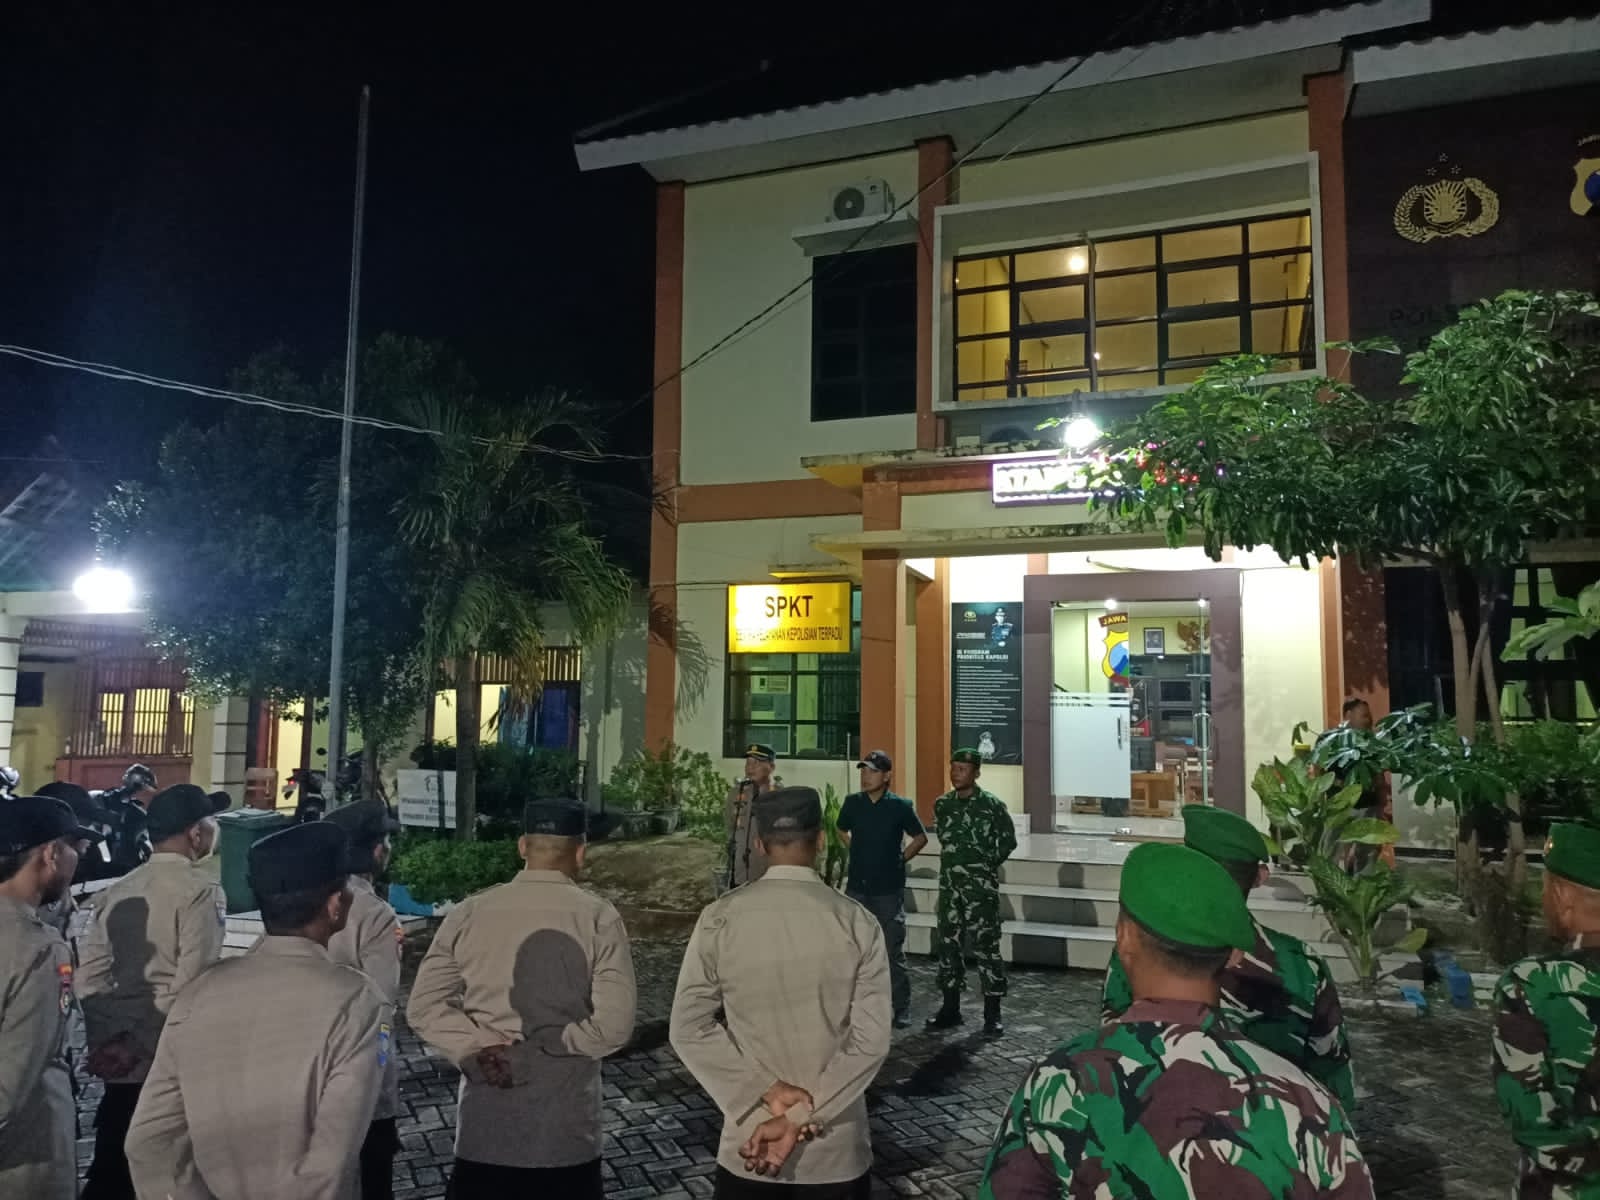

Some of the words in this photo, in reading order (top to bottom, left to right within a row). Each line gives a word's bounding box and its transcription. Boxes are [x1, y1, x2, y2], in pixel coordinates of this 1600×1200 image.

[765, 595, 814, 618] SPKT
[1103, 615, 1127, 625] JAWA
[786, 627, 817, 641] KEPOLISIAN
[818, 626, 842, 641] TERPADU
